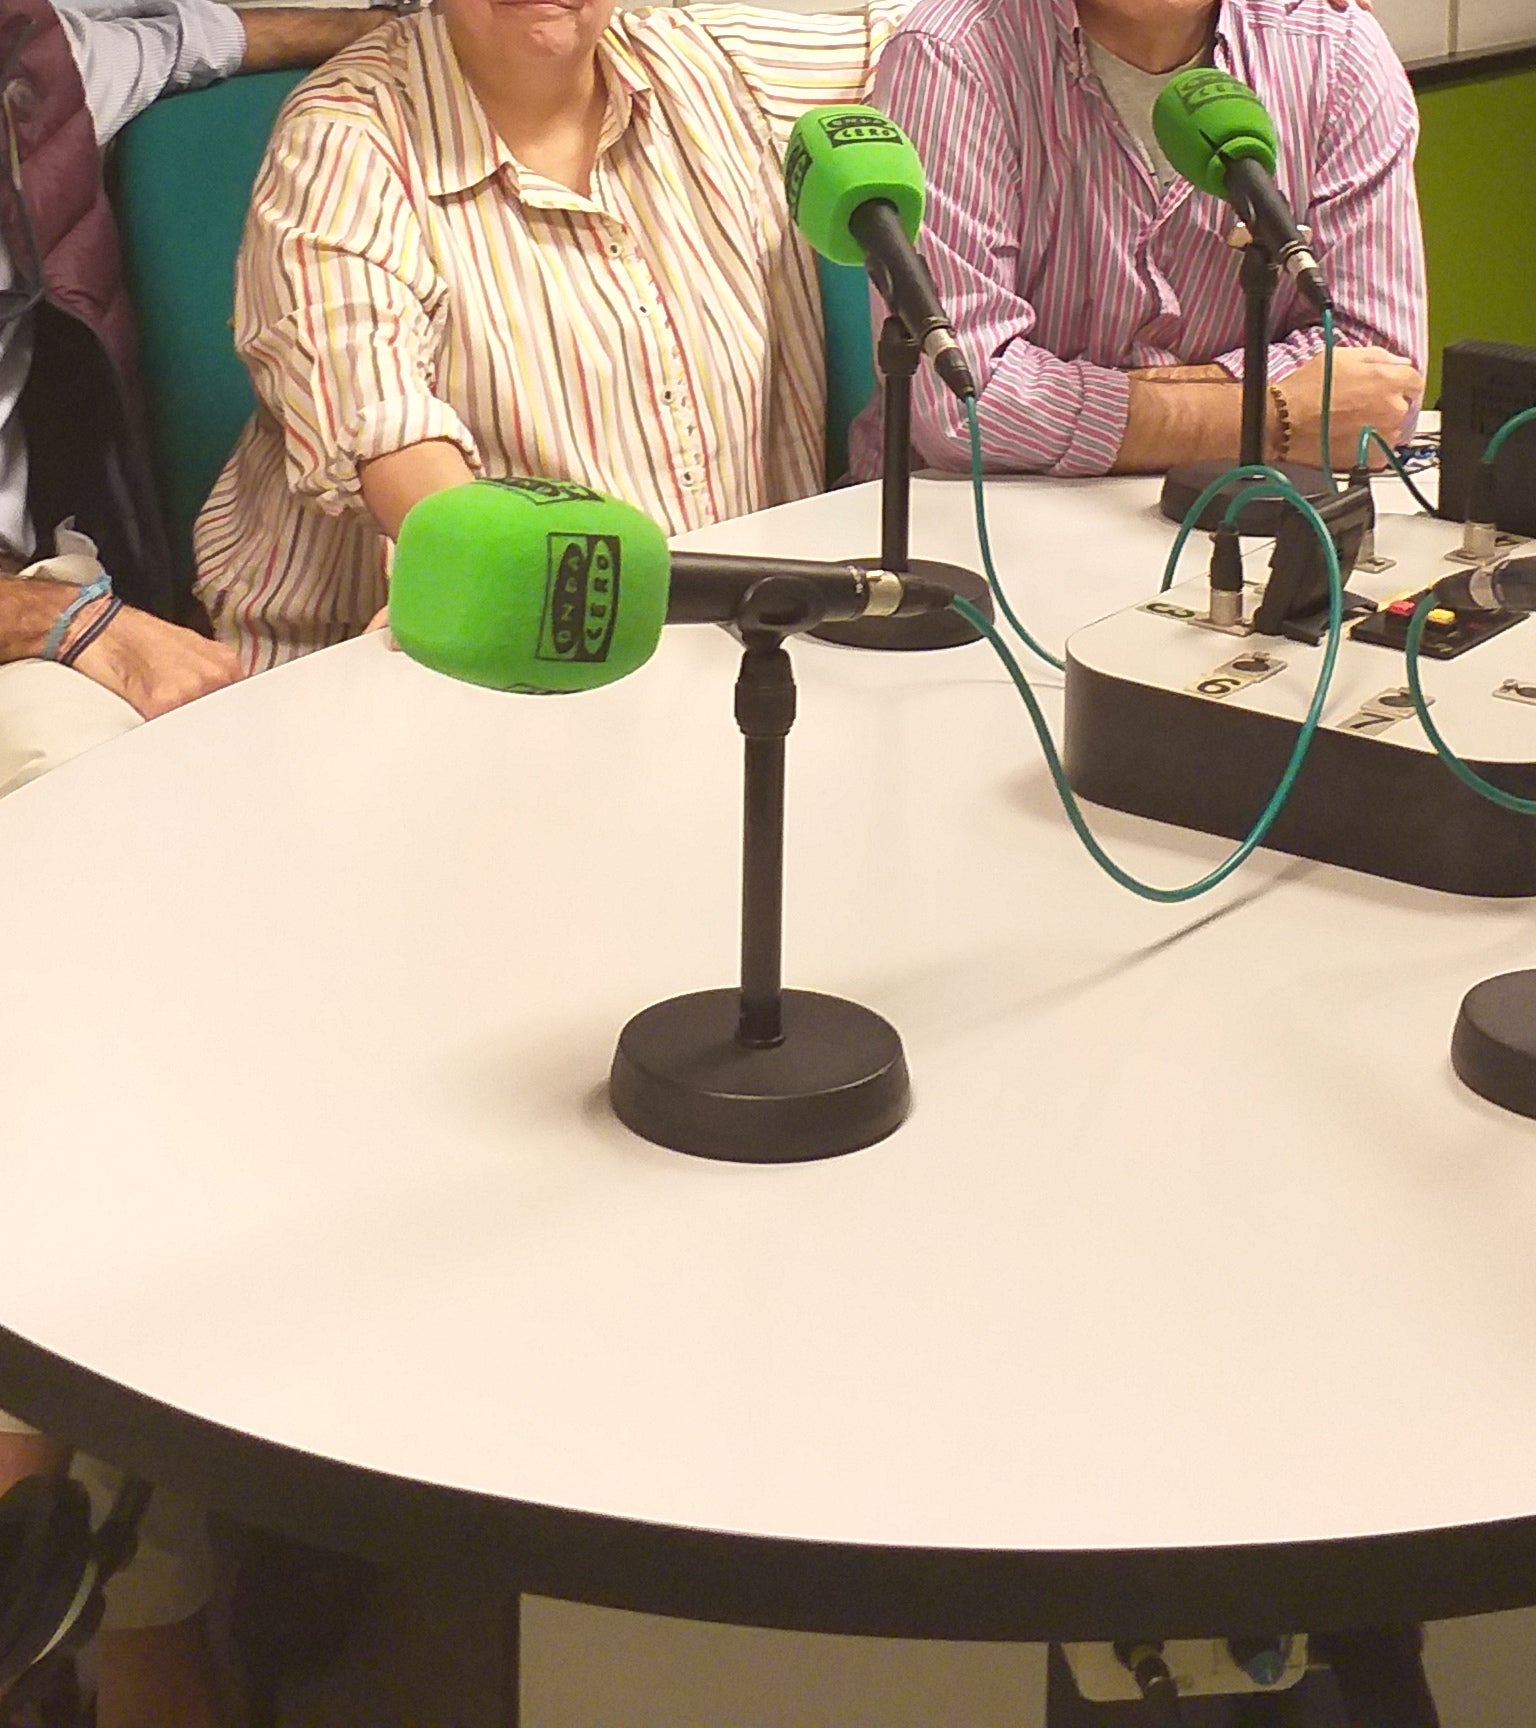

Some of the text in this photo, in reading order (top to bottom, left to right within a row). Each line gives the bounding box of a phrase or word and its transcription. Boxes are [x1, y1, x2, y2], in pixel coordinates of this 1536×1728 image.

[842, 128, 891, 138] CERO
[556, 555, 581, 644] ONDA
[586, 554, 609, 641] CERO
